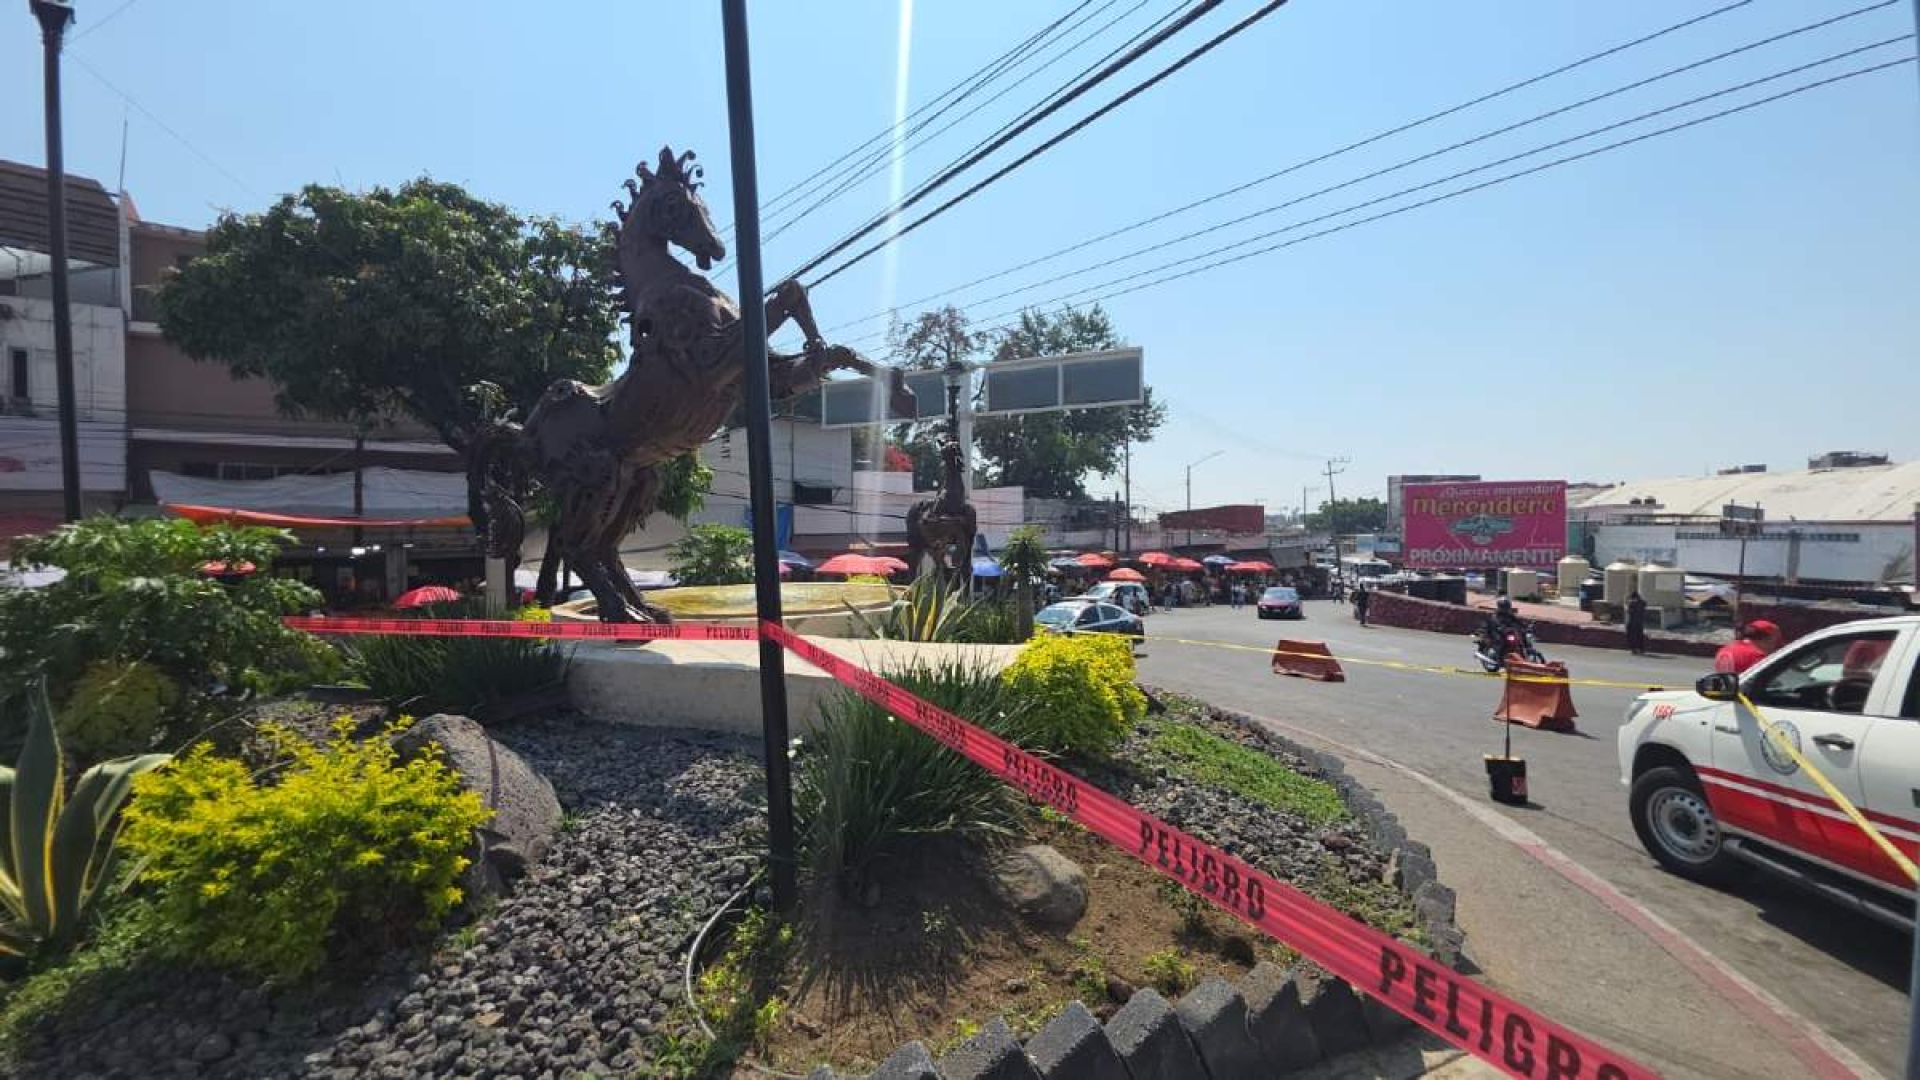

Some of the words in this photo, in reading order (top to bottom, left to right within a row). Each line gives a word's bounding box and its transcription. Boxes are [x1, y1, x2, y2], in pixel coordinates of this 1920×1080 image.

[1412, 497, 1557, 516] Merendero
[1409, 543, 1562, 564] PRÓXIMAMENTE
[706, 626, 750, 640] PELIGRO
[1004, 749, 1078, 814] PELIGRO
[1139, 820, 1266, 921] PELIGRO
[1379, 945, 1631, 1080] PELIGR
